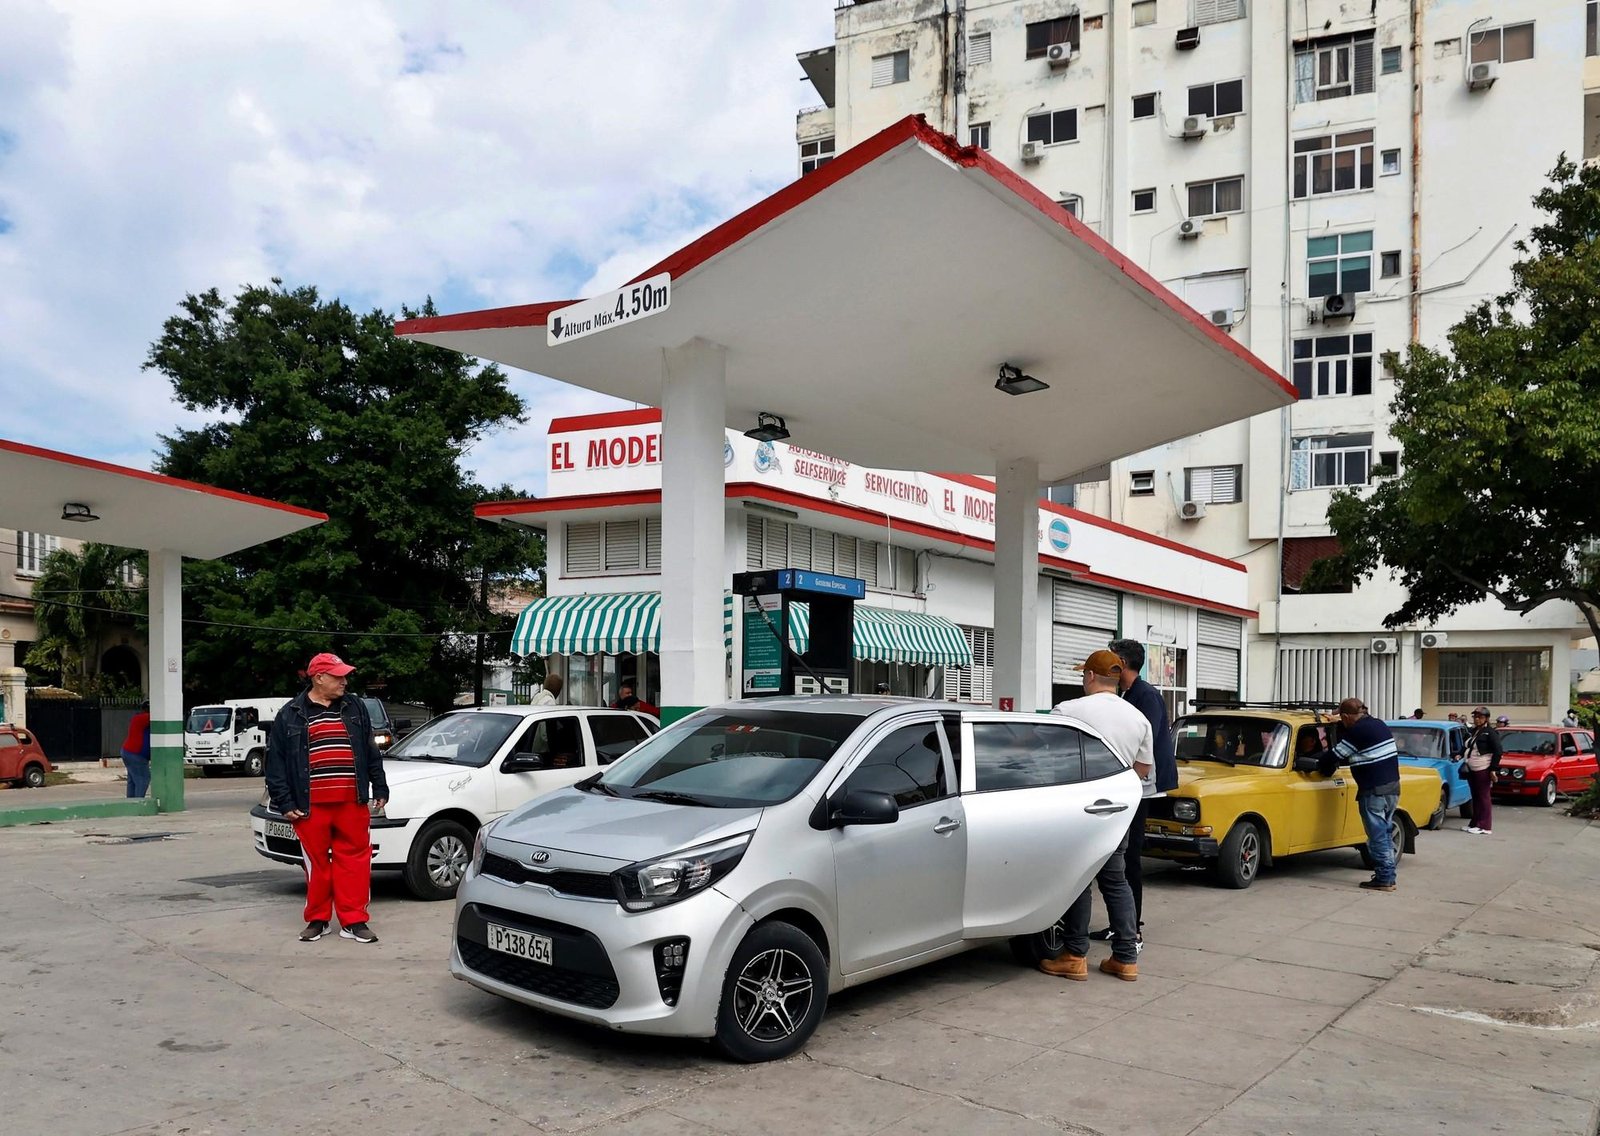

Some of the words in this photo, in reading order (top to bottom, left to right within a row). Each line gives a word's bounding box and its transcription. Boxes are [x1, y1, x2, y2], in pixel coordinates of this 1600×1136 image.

[564, 319, 591, 338] Altura
[594, 311, 615, 328] Máx.
[614, 283, 667, 320] 4.50m
[552, 441, 574, 470] EL
[795, 458, 847, 487] SELFSERVICE
[865, 472, 928, 505] SERVICENTRO
[943, 489, 956, 513] EL
[798, 574, 803, 585] 2
[532, 851, 546, 861] KIA
